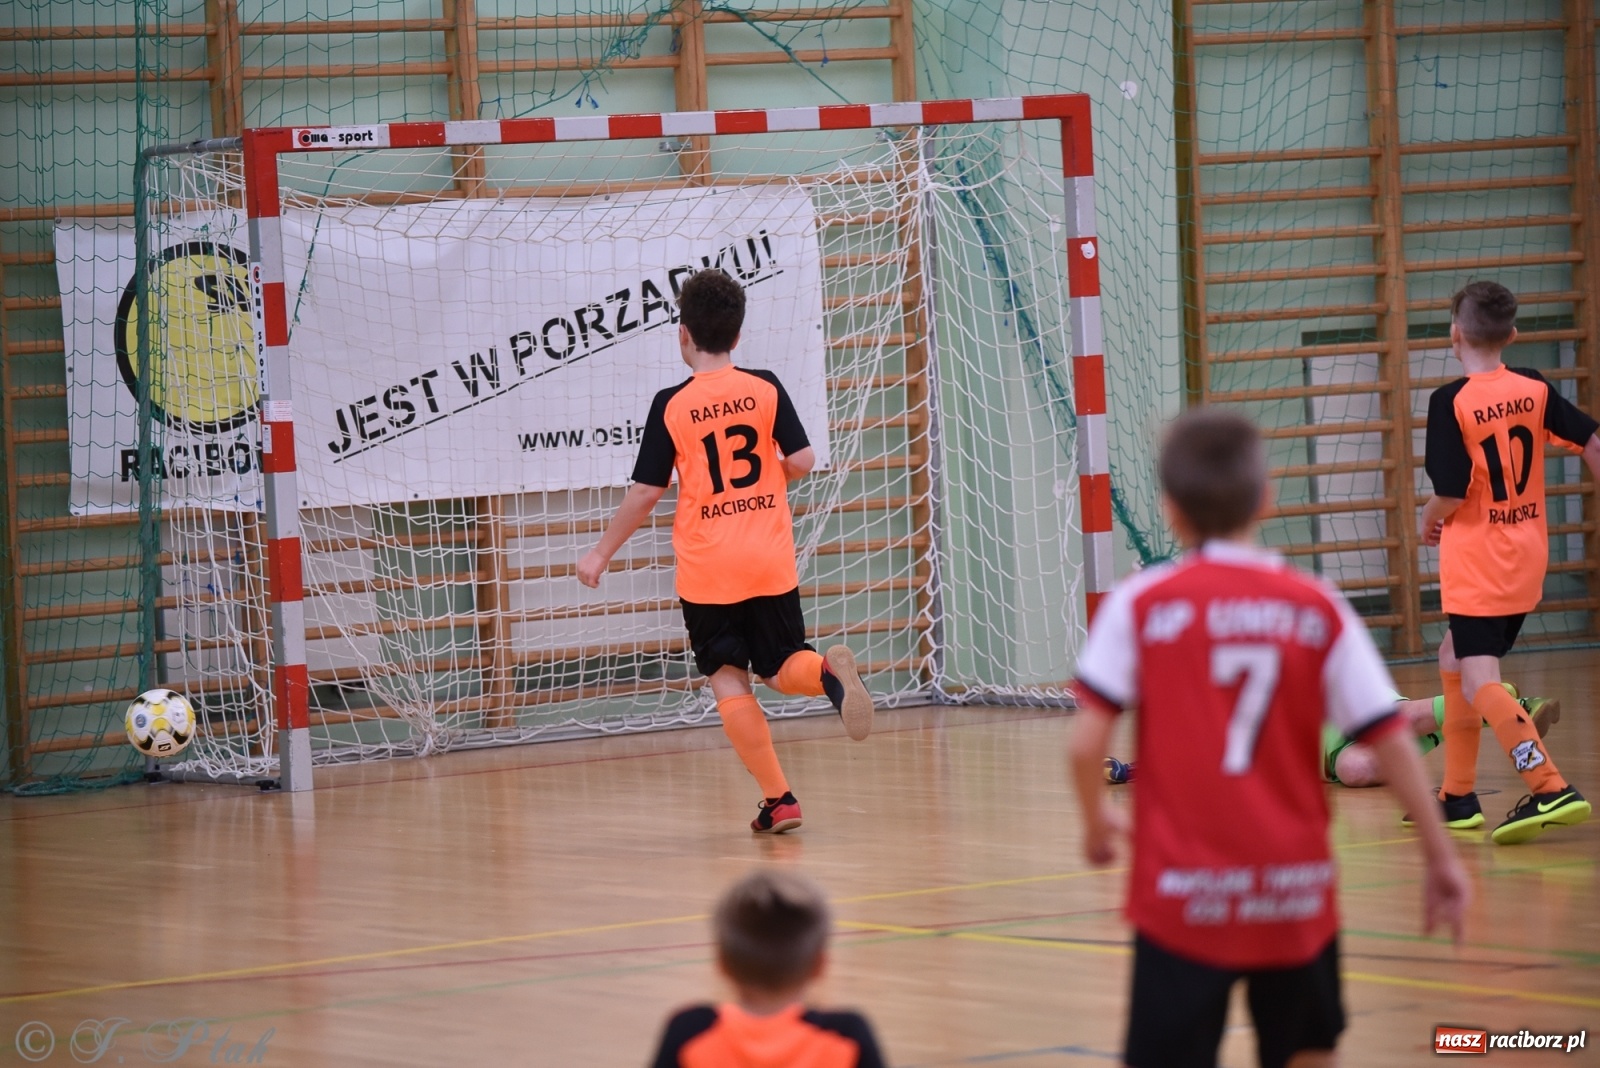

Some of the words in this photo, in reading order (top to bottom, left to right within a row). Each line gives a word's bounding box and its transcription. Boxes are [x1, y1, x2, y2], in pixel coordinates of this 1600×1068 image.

[338, 130, 373, 144] sport
[328, 369, 439, 454] JEST
[451, 345, 500, 398] W
[690, 397, 756, 424] RAFAKO
[1473, 397, 1534, 425] RAFAKO
[701, 424, 762, 495] 13
[1479, 424, 1533, 502] 10
[701, 494, 776, 519] RACIBORZ
[1210, 643, 1281, 775] 7
